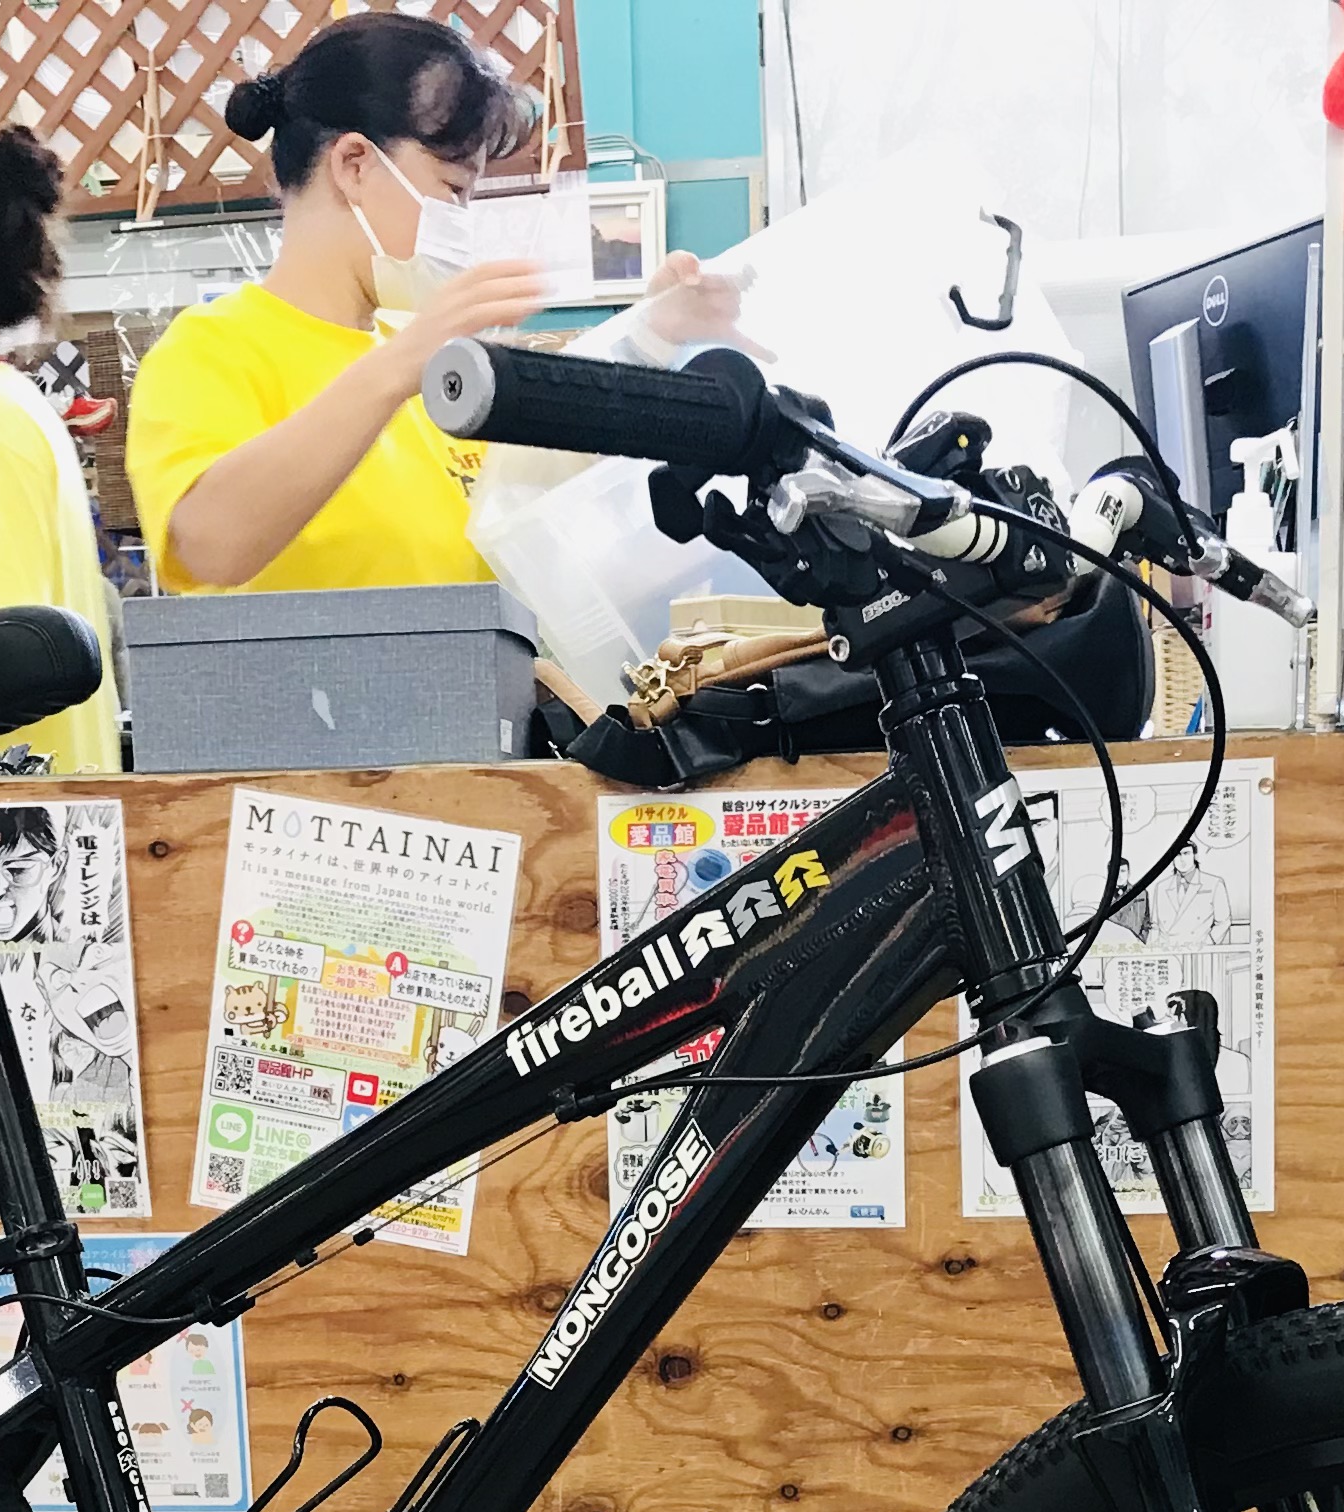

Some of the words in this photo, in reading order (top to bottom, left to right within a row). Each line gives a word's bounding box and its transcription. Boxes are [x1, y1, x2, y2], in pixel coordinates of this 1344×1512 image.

[635, 806, 688, 821] リサイクル
[722, 797, 840, 813] 総合リサイクルショッ
[629, 823, 696, 847] 愛品館
[723, 811, 824, 836] 愛品館千
[76, 834, 102, 927] 電子レンジは
[240, 860, 253, 872] It
[257, 863, 268, 875] is
[284, 869, 338, 888] message
[342, 878, 371, 893] from
[376, 883, 410, 903] Japan
[415, 890, 428, 903] to
[432, 893, 453, 908] the
[256, 939, 305, 961] どんな物を
[506, 934, 685, 1078] fireball
[220, 1120, 243, 1133] LINE
[529, 1126, 710, 1386] MONGOOSE
[107, 1400, 129, 1447] PRO
